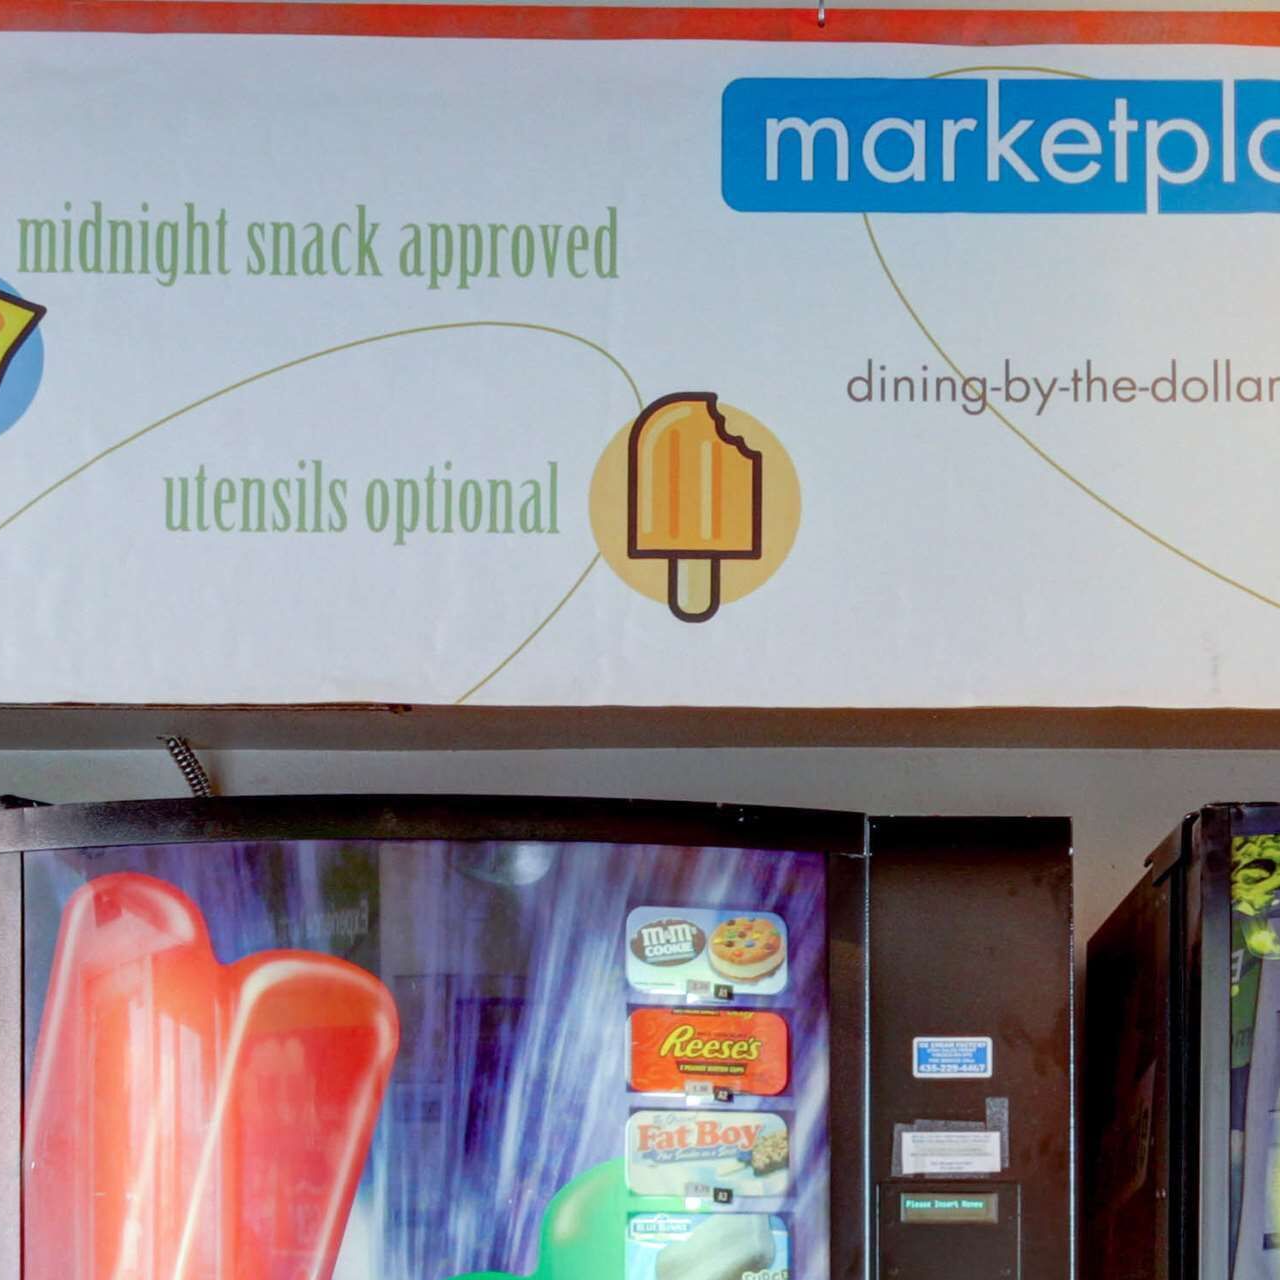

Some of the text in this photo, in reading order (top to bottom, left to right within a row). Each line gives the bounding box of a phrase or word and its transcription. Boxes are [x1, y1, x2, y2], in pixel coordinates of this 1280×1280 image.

[16, 200, 621, 290] midnight snack approved
[162, 458, 560, 547] utensils optional
[660, 1024, 762, 1061] Reese's
[637, 1119, 764, 1152] Fat Boy
[906, 1200, 931, 1209] Please
[934, 1200, 959, 1209] Insert
